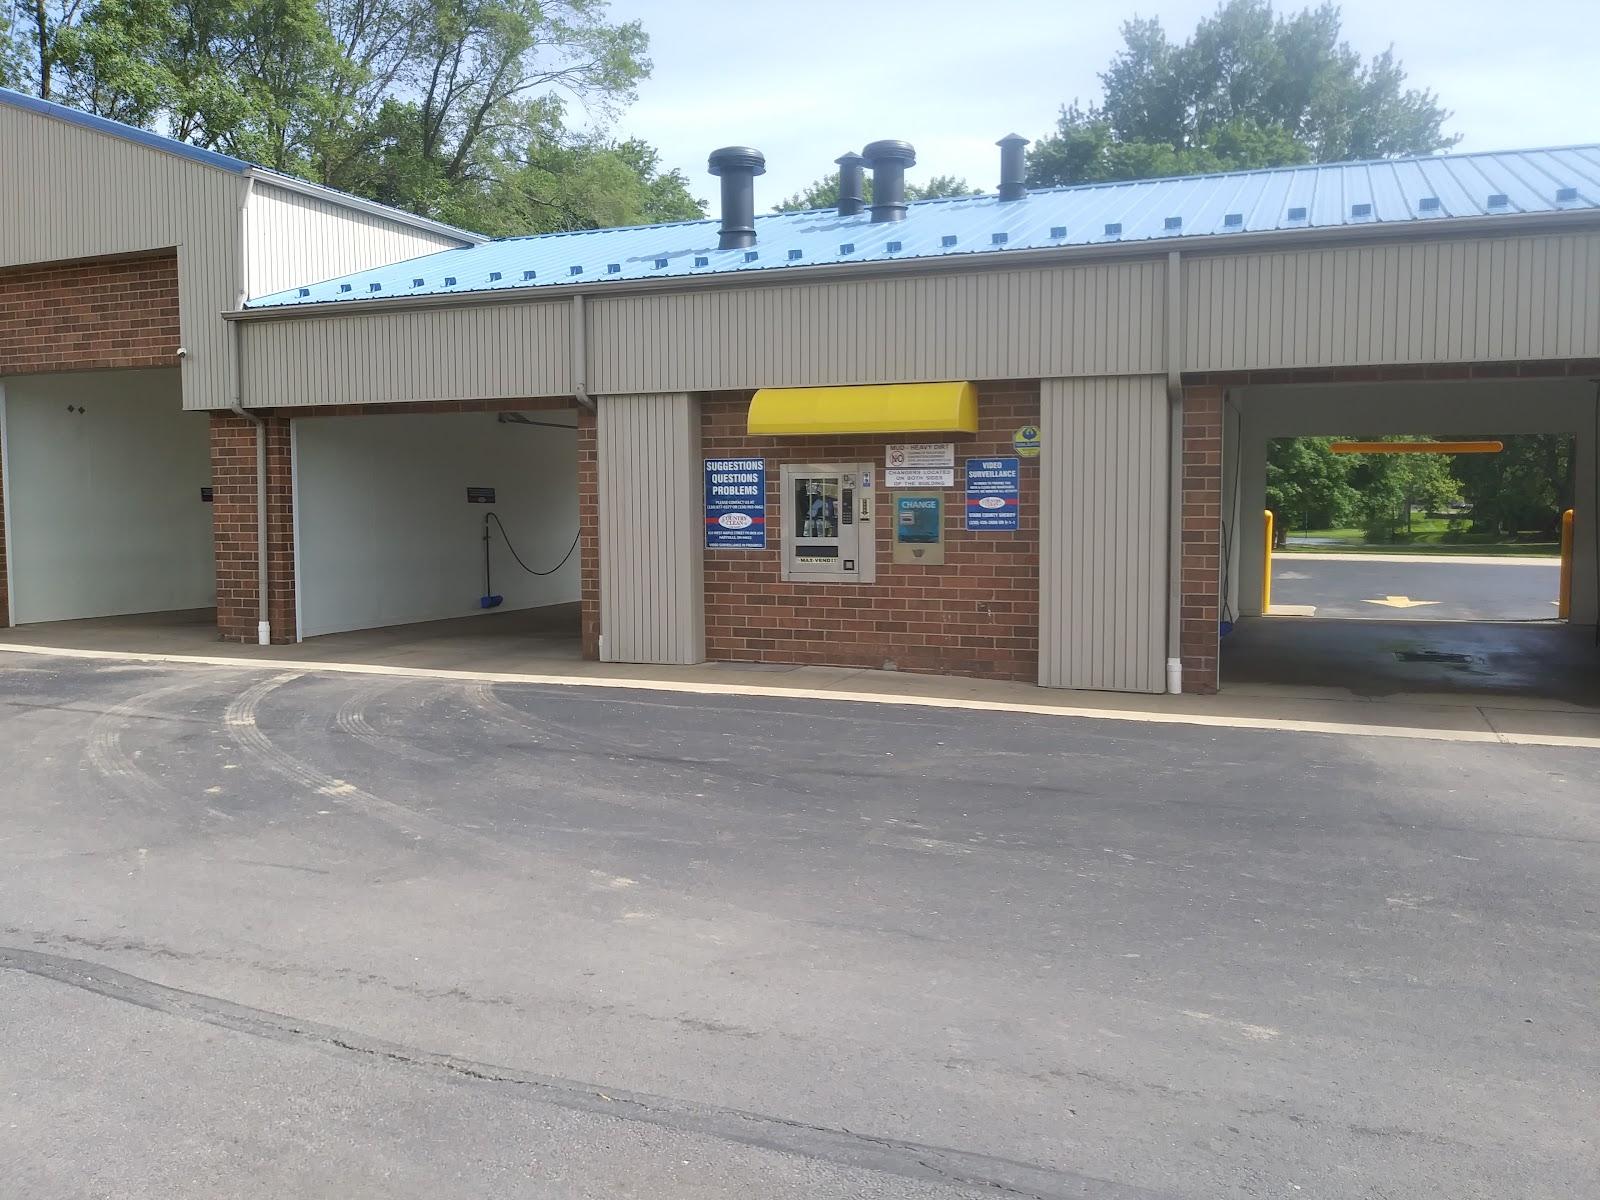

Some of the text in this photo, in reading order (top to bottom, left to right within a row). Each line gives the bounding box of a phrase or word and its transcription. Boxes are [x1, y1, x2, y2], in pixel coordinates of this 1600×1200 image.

[706, 461, 763, 471] SUGGESTIONS
[711, 473, 758, 484] QUESTIONS
[968, 470, 1016, 478] SURVEILLANCE
[712, 485, 758, 496] PROBLEMS
[903, 500, 936, 509] CHANGE
